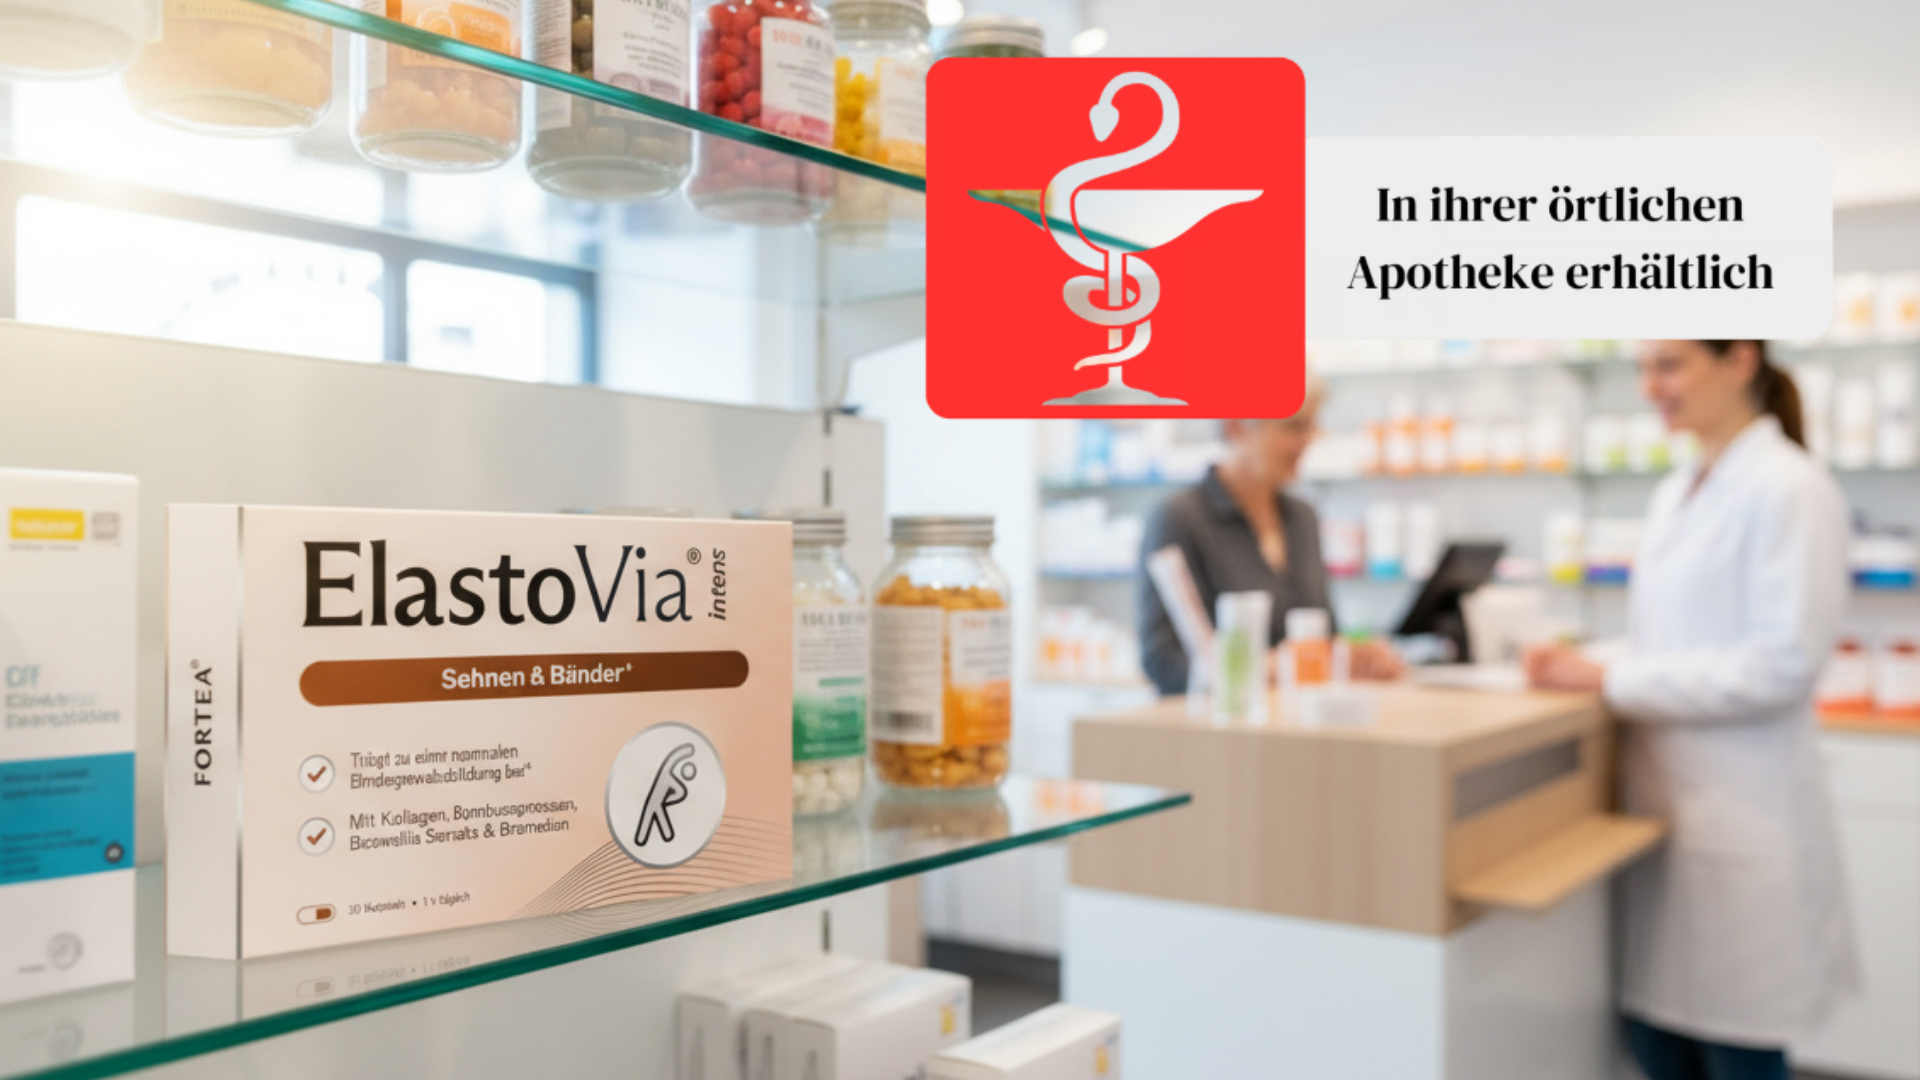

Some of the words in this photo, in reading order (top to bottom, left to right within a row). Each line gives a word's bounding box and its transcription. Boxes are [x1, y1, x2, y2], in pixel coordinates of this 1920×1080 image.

[708, 548, 727, 621] intens
[441, 667, 525, 690] Sehnen
[530, 665, 545, 686] &
[483, 822, 496, 838] &
